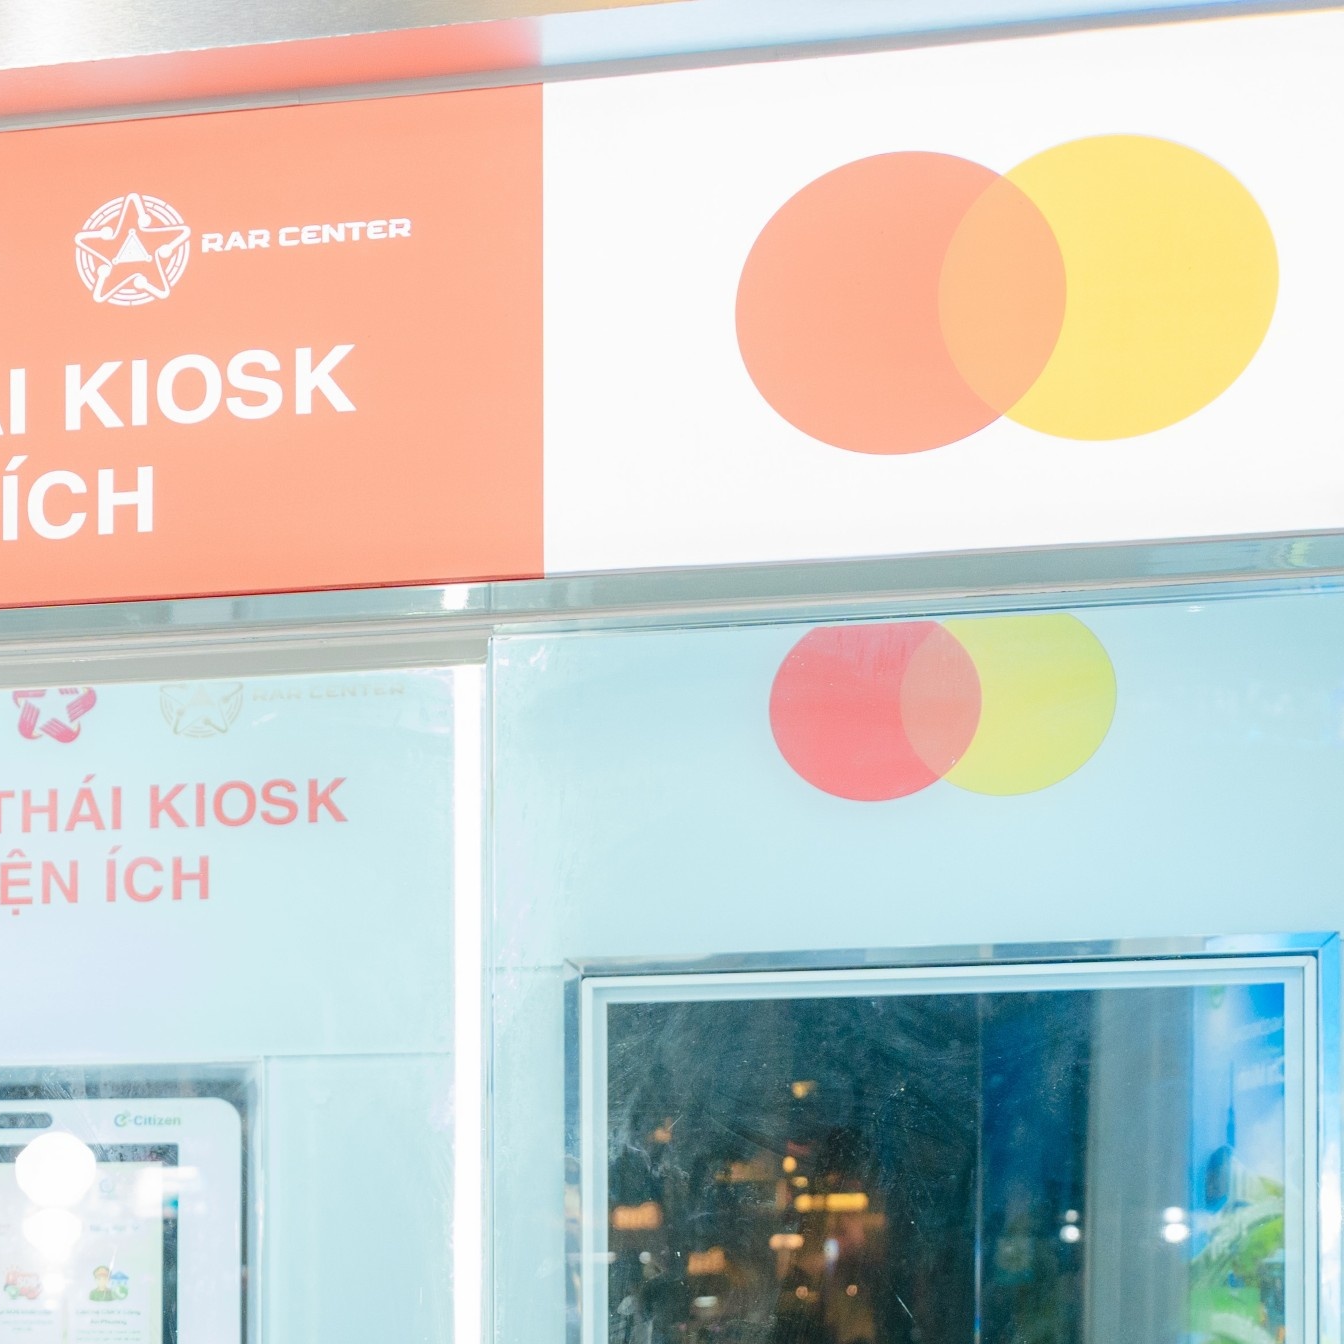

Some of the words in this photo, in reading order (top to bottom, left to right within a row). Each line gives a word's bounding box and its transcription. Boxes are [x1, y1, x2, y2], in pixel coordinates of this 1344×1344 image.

[202, 229, 270, 253] RAR
[279, 218, 411, 247] CENTER
[64, 344, 357, 431] KIOSK
[2, 456, 155, 542] ÍCH
[149, 777, 348, 829] KIOSK
[106, 846, 210, 903] ÍCH
